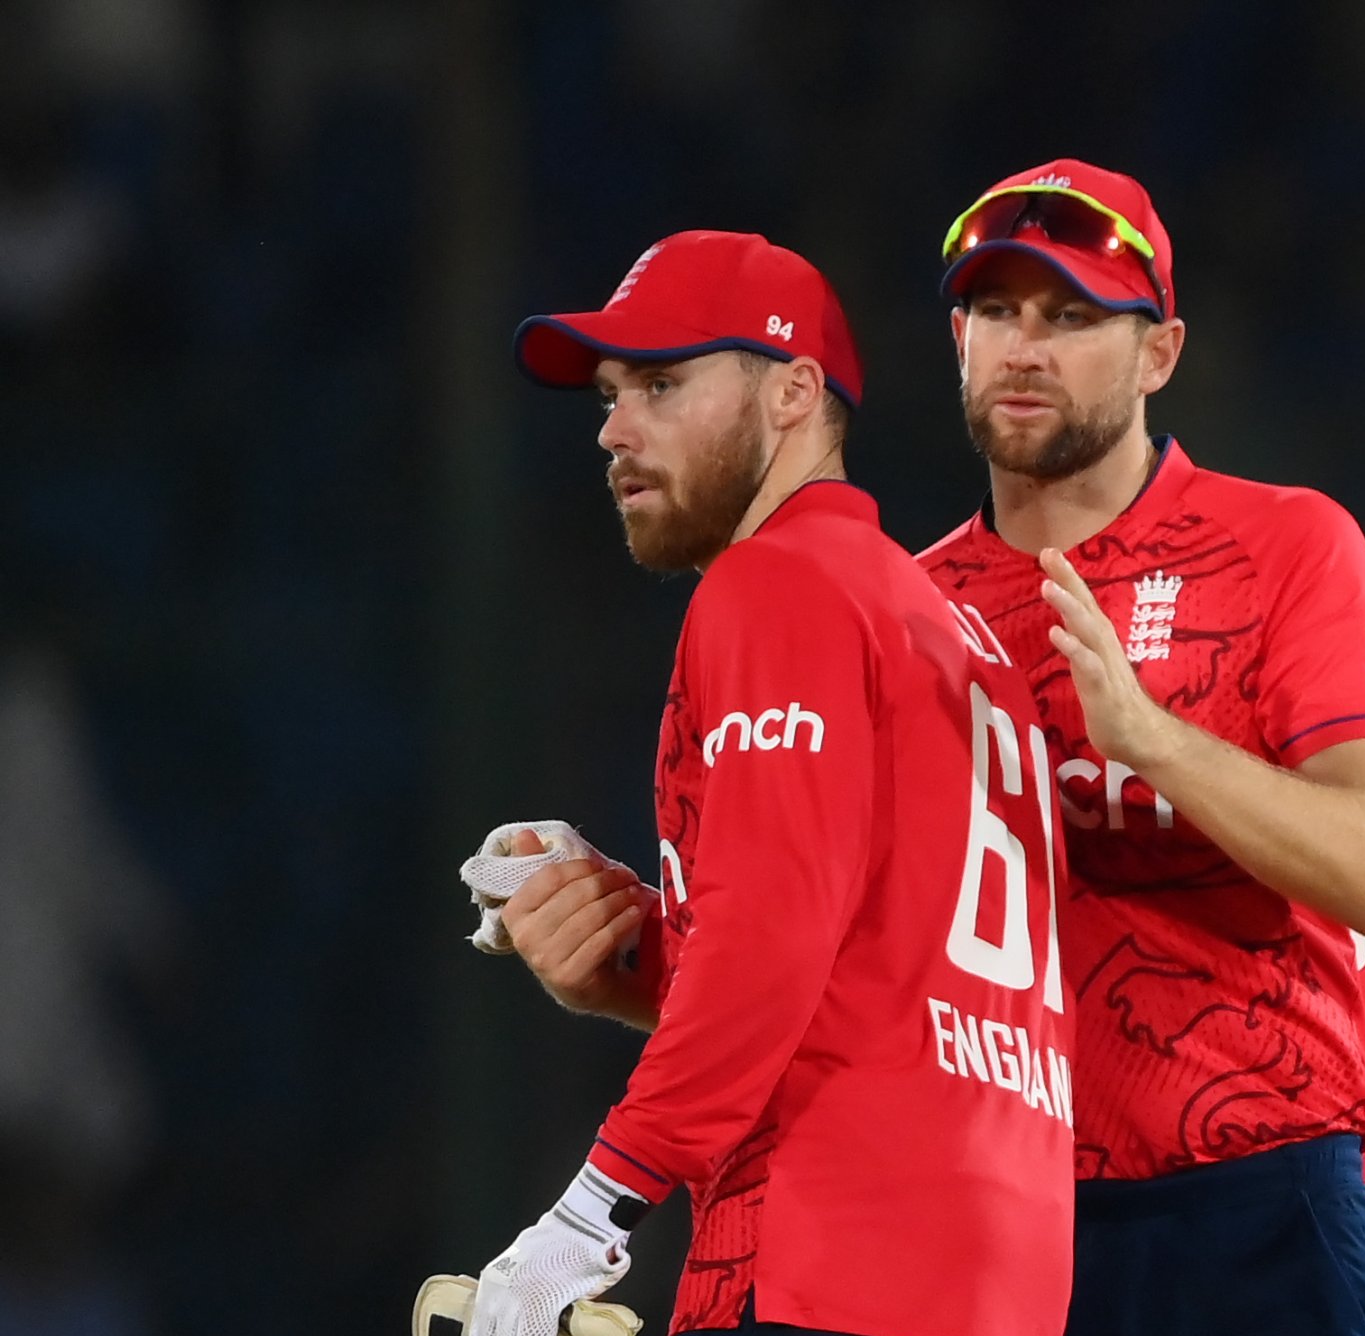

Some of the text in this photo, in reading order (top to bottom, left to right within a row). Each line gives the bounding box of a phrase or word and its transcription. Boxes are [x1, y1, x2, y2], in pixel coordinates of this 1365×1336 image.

[765, 314, 794, 342] 94
[945, 681, 1065, 1015] 61
[927, 996, 1074, 1129] ENGLAN
